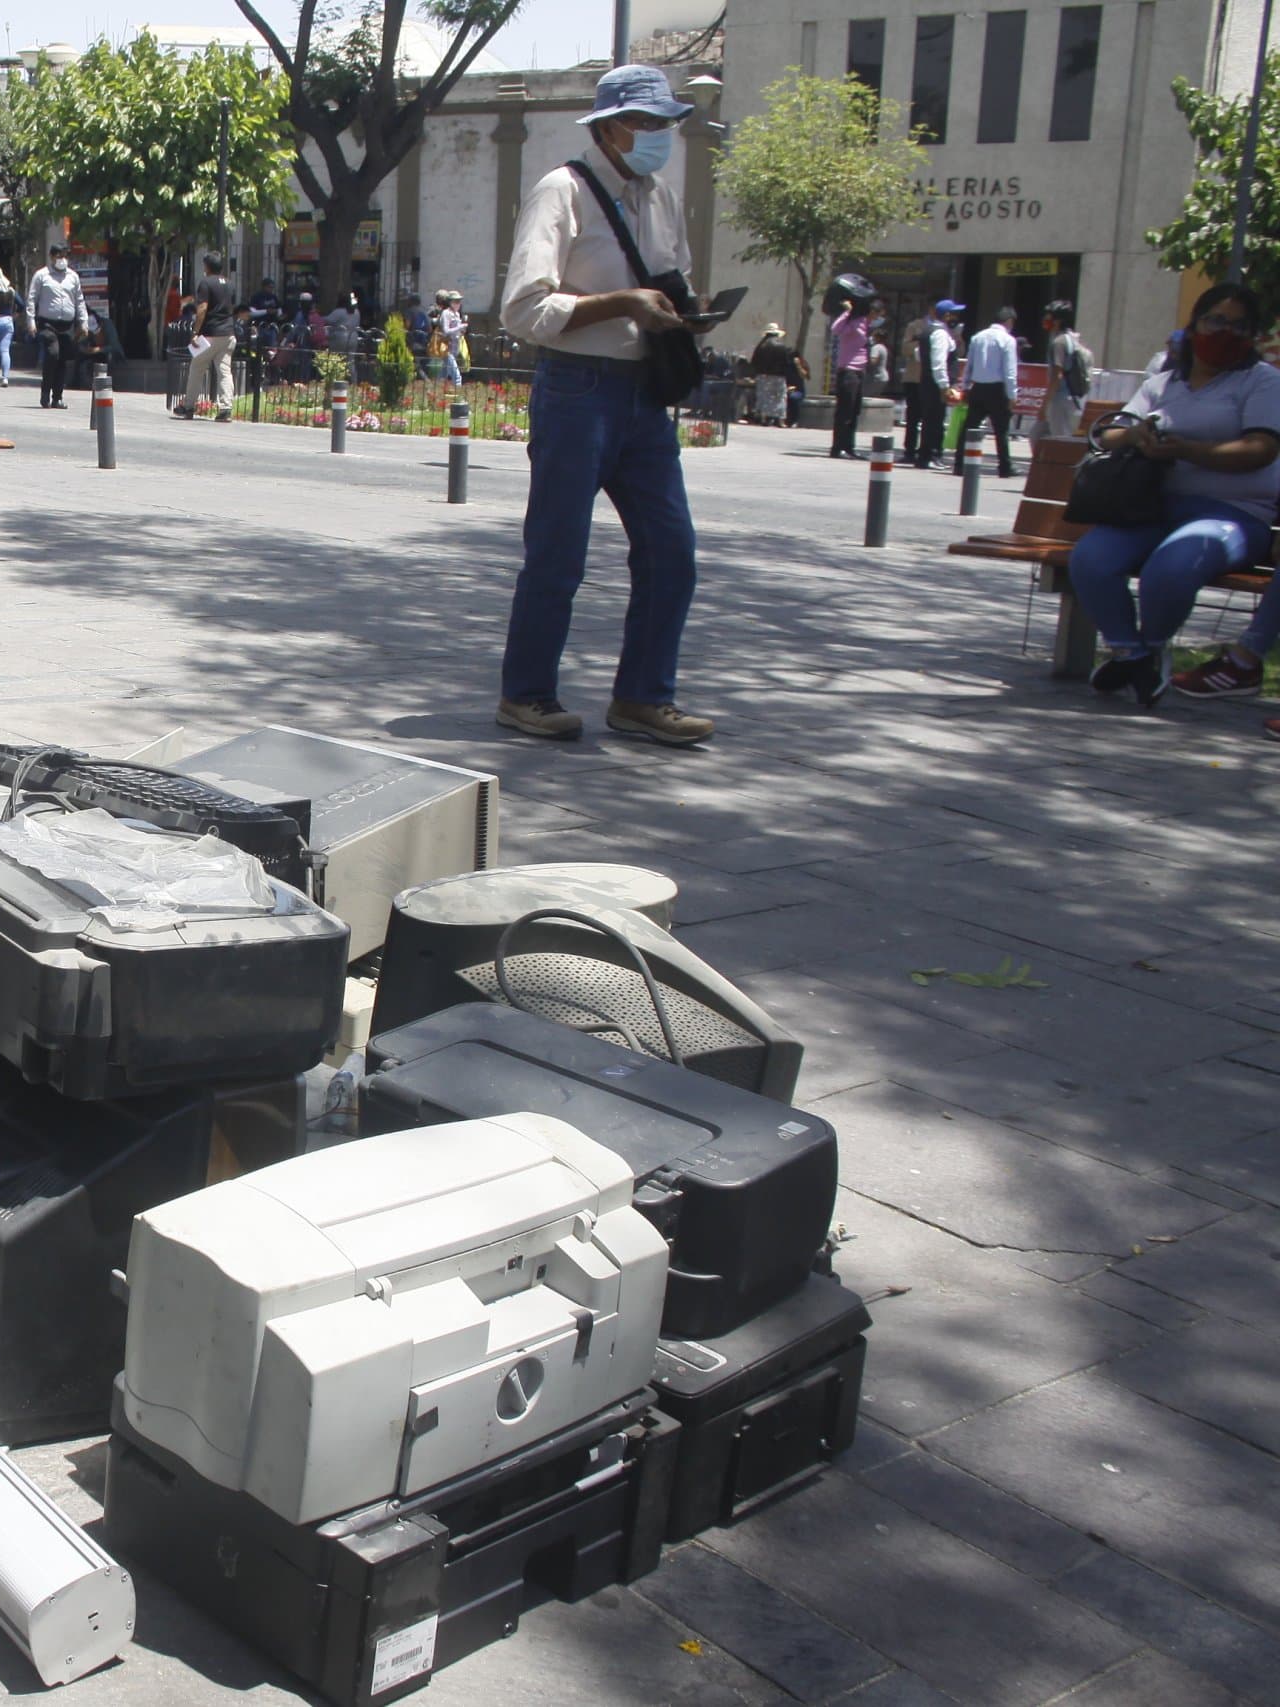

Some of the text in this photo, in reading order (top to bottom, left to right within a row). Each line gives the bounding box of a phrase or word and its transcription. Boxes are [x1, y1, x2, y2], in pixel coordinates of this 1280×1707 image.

[906, 176, 1021, 196] ALERIAS
[945, 200, 1043, 219] AGOSTO
[1006, 261, 1050, 274] SALIDA
